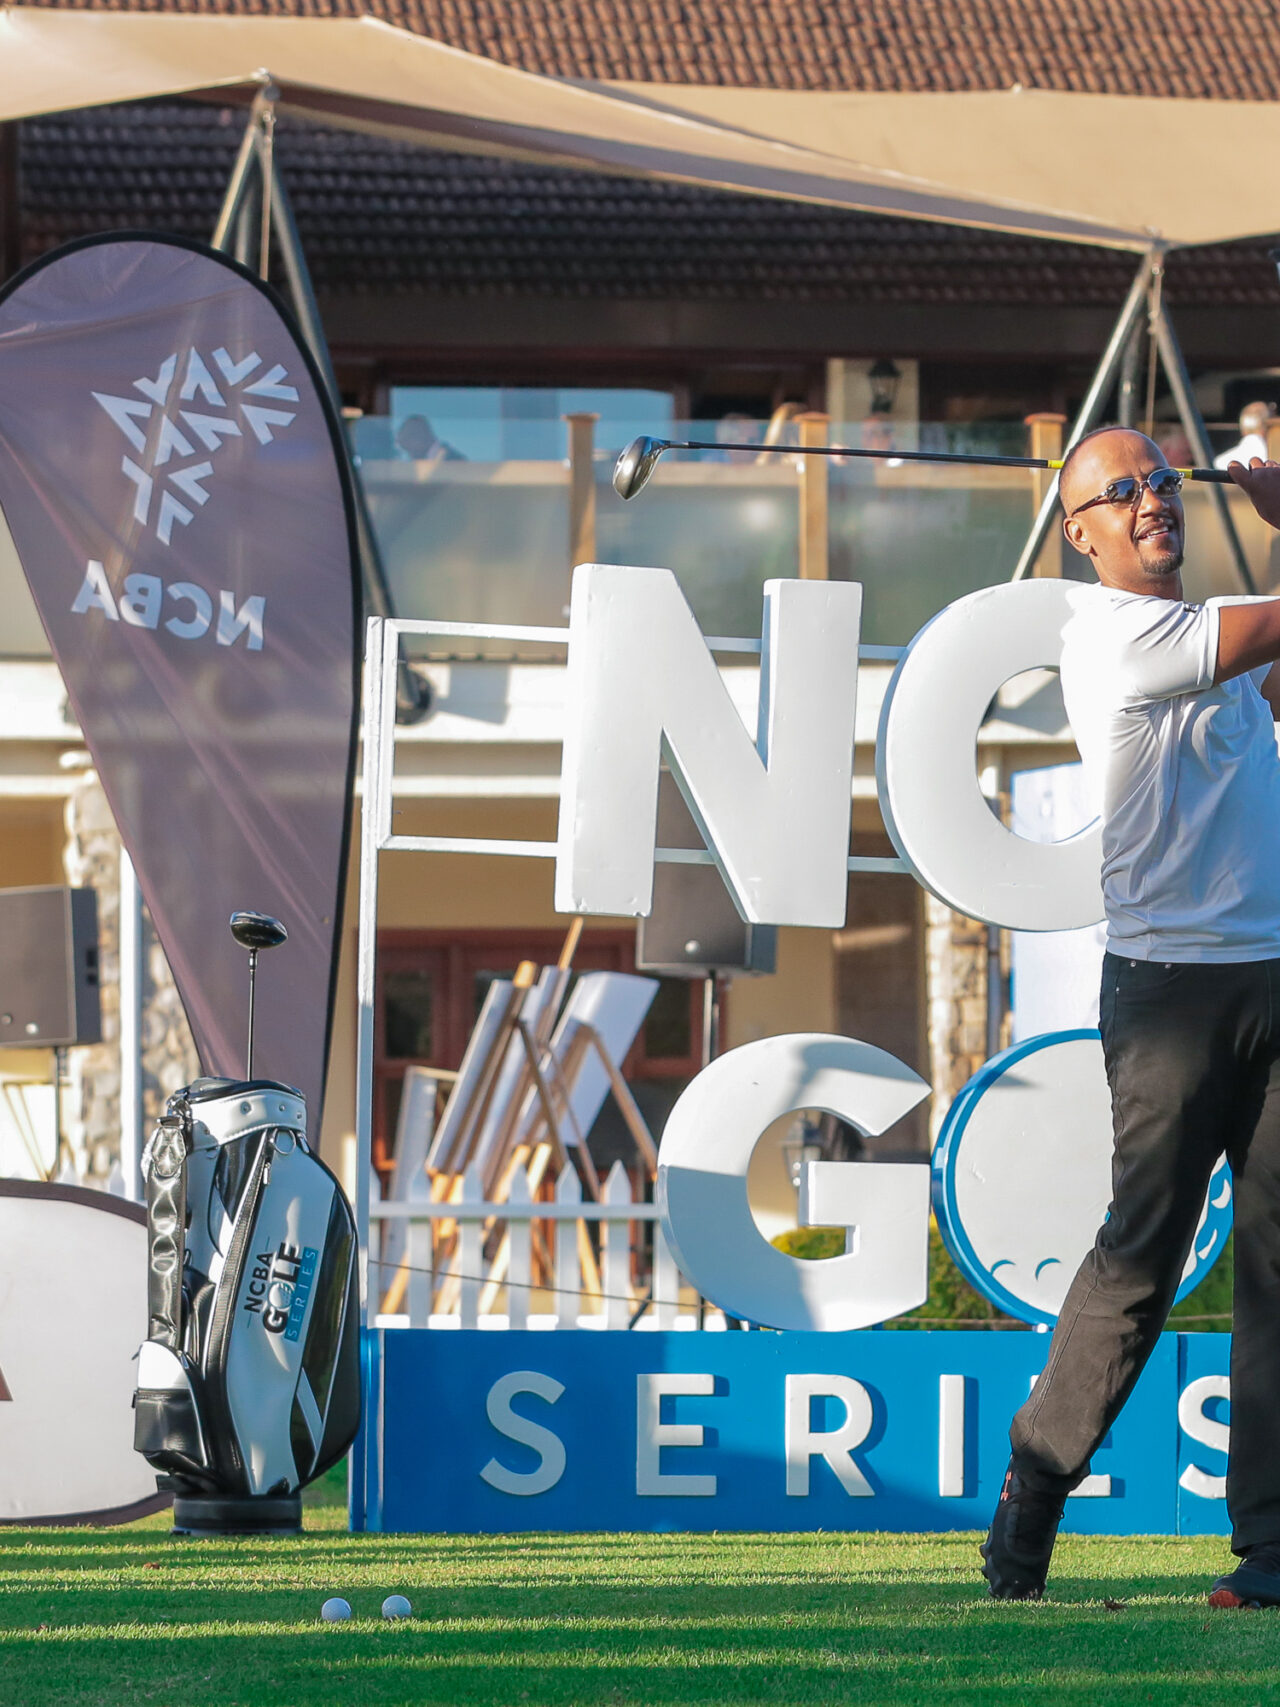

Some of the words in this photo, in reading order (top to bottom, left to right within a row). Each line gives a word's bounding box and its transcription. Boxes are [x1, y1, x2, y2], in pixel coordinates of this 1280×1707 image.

[243, 1252, 274, 1313] NCBA
[262, 1242, 302, 1334] GOLF
[287, 1249, 316, 1338] SERIES
[478, 1370, 1232, 1500] SERIS
